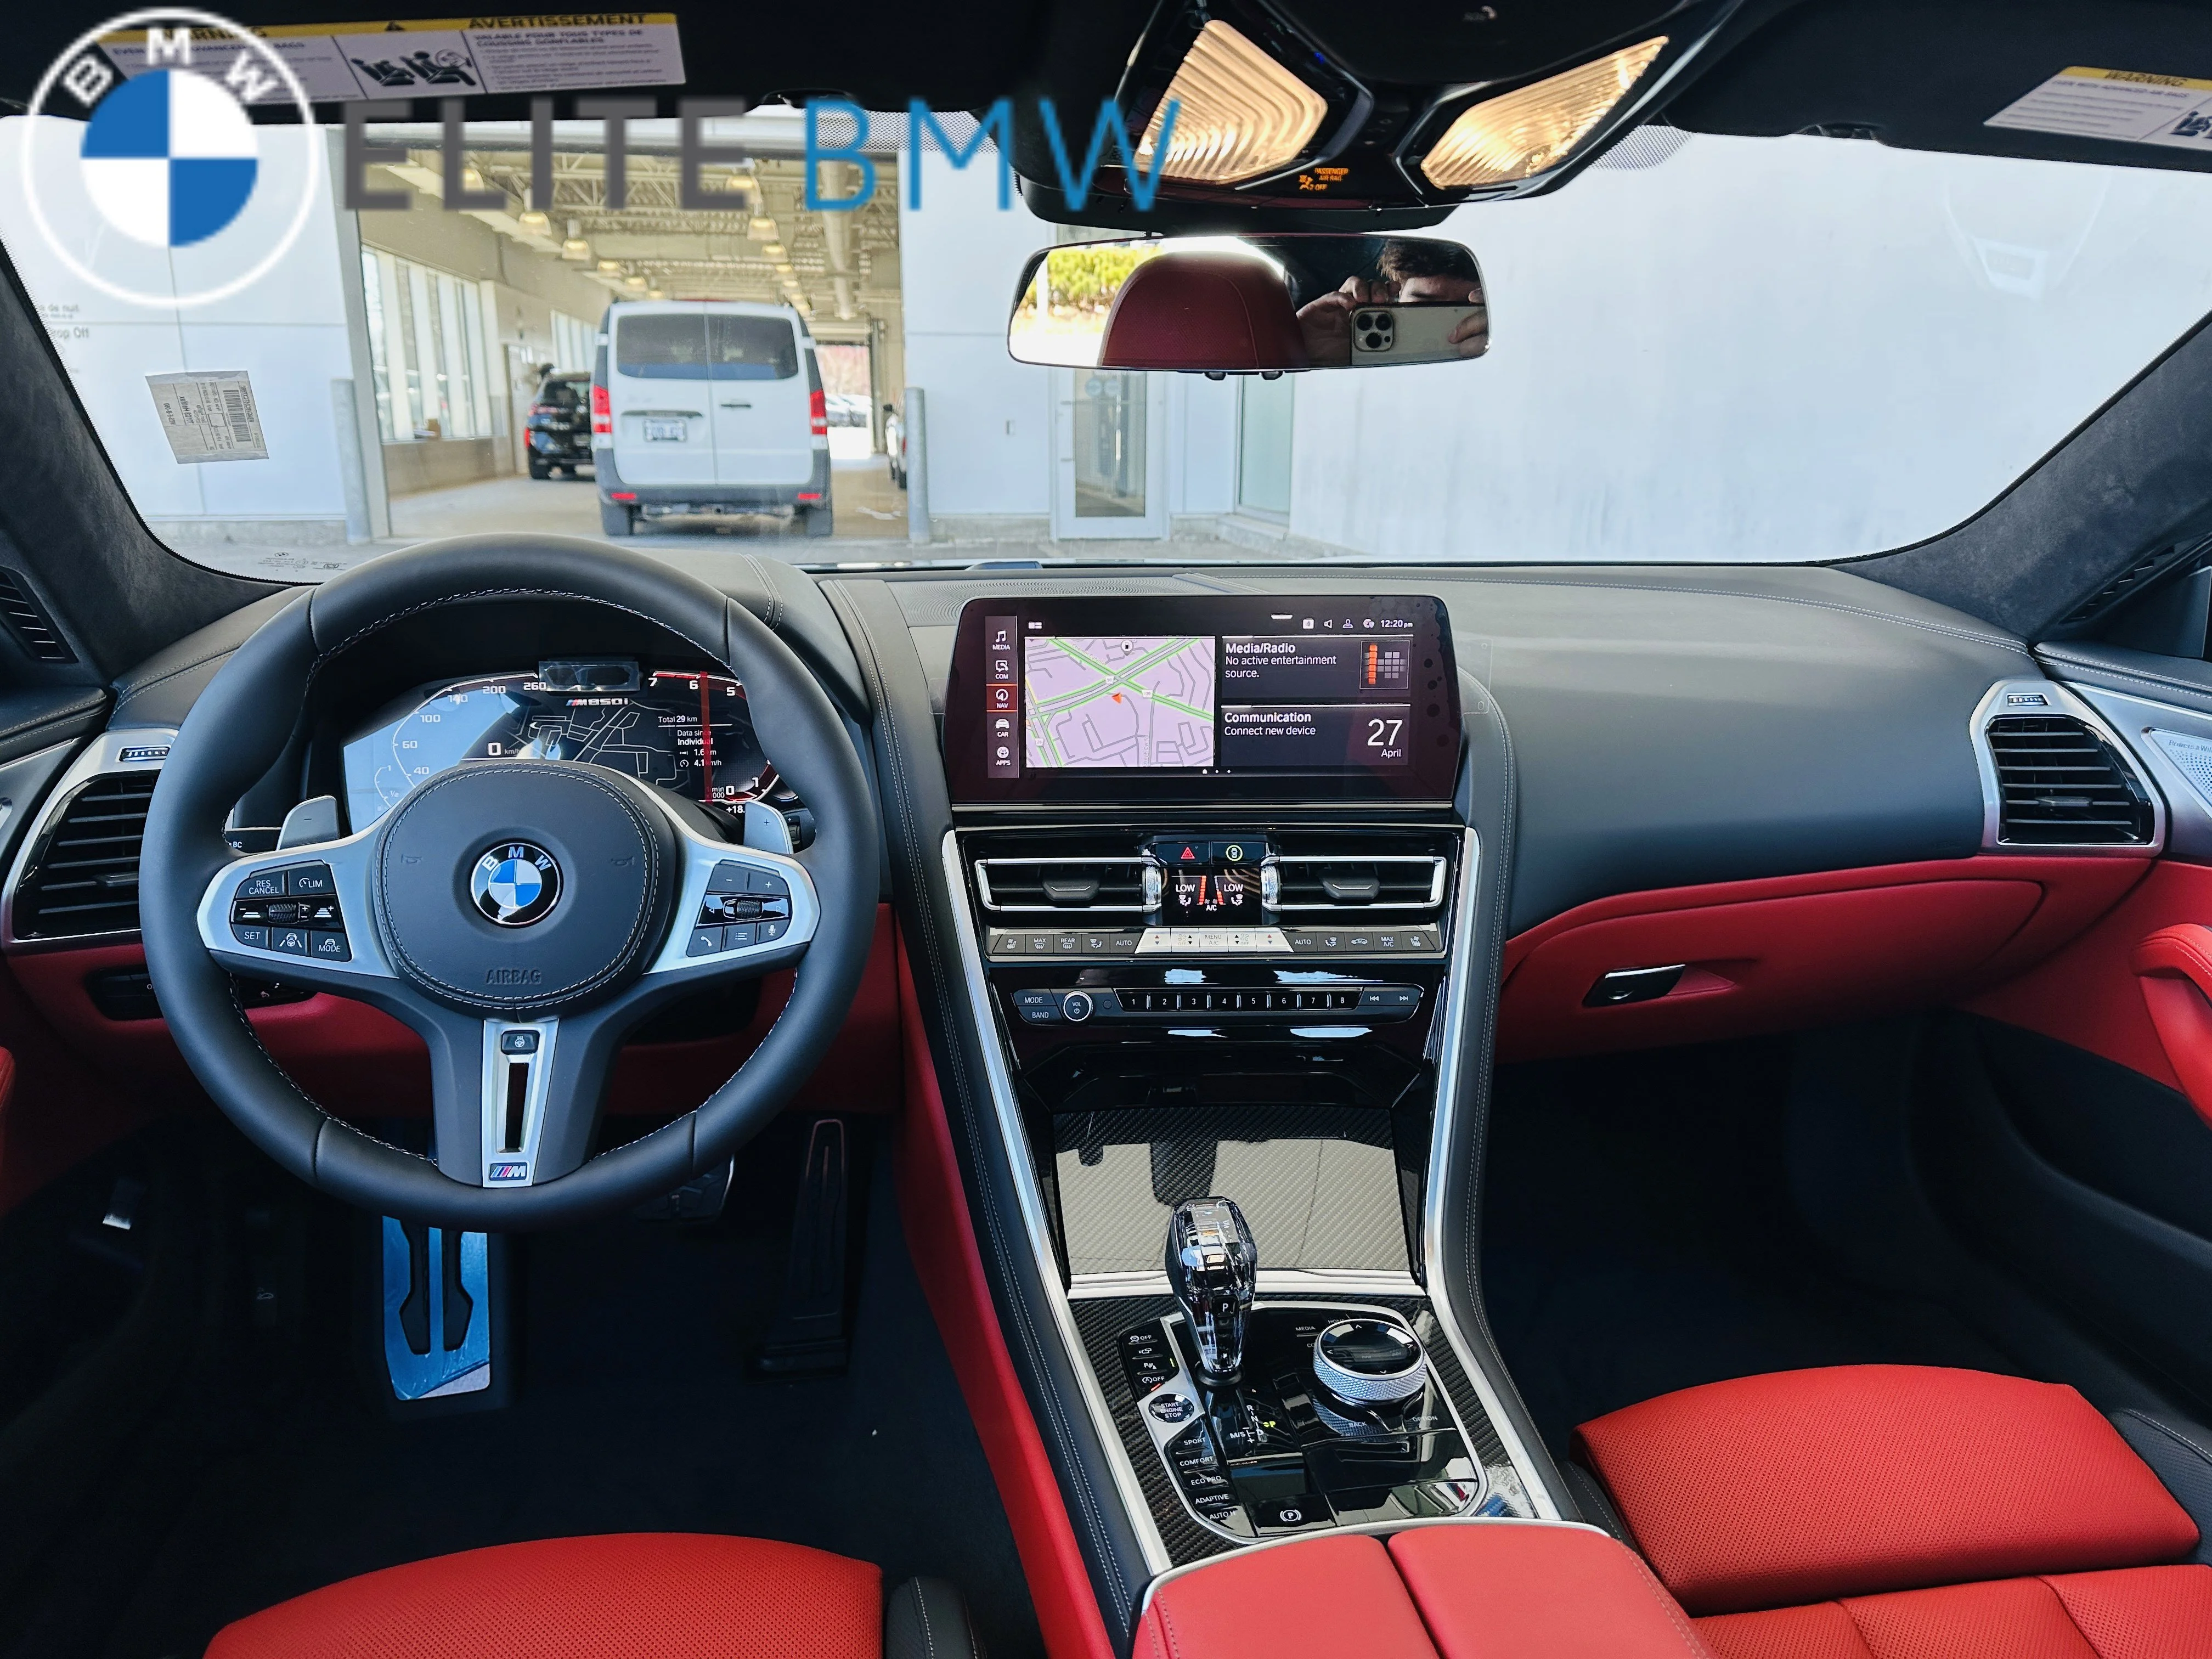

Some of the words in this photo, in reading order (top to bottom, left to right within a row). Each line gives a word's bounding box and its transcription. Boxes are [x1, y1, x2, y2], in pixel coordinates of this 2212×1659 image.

[469, 15, 645, 29] AVERTISSEMENT
[1226, 642, 1296, 654] Media/Radio
[1225, 657, 1239, 665] No
[1241, 656, 1269, 665] active
[1271, 655, 1337, 665] entertainment
[1225, 669, 1260, 678] source.
[523, 681, 546, 690] 260
[648, 678, 658, 686] 7
[690, 680, 698, 690] 6
[483, 686, 506, 694] 200
[726, 687, 736, 696] 5
[420, 714, 441, 723] 100
[1224, 712, 1311, 723] Communication
[1224, 726, 1263, 736] Connect
[1286, 726, 1316, 736] device
[1367, 719, 1403, 747] 27
[402, 741, 417, 749] 60
[488, 742, 501, 756] 0
[1381, 748, 1402, 758] April
[414, 766, 429, 775] 40
[752, 777, 759, 787] 1
[726, 786, 735, 795] 0
[482, 846, 552, 872] BMW
[308, 880, 323, 888] LIM
[1176, 884, 1195, 892] LOW
[1223, 884, 1243, 892] LOW
[249, 887, 279, 895] CANCEL
[244, 932, 260, 940] SET
[486, 969, 541, 985] AIRBAG
[1222, 1303, 1229, 1312] P
[1184, 1437, 1206, 1446] SPORT
[1180, 1457, 1214, 1466] COMFORT
[1195, 1493, 1229, 1504] ADAPTIVE
[1210, 1511, 1229, 1520] AUTO
